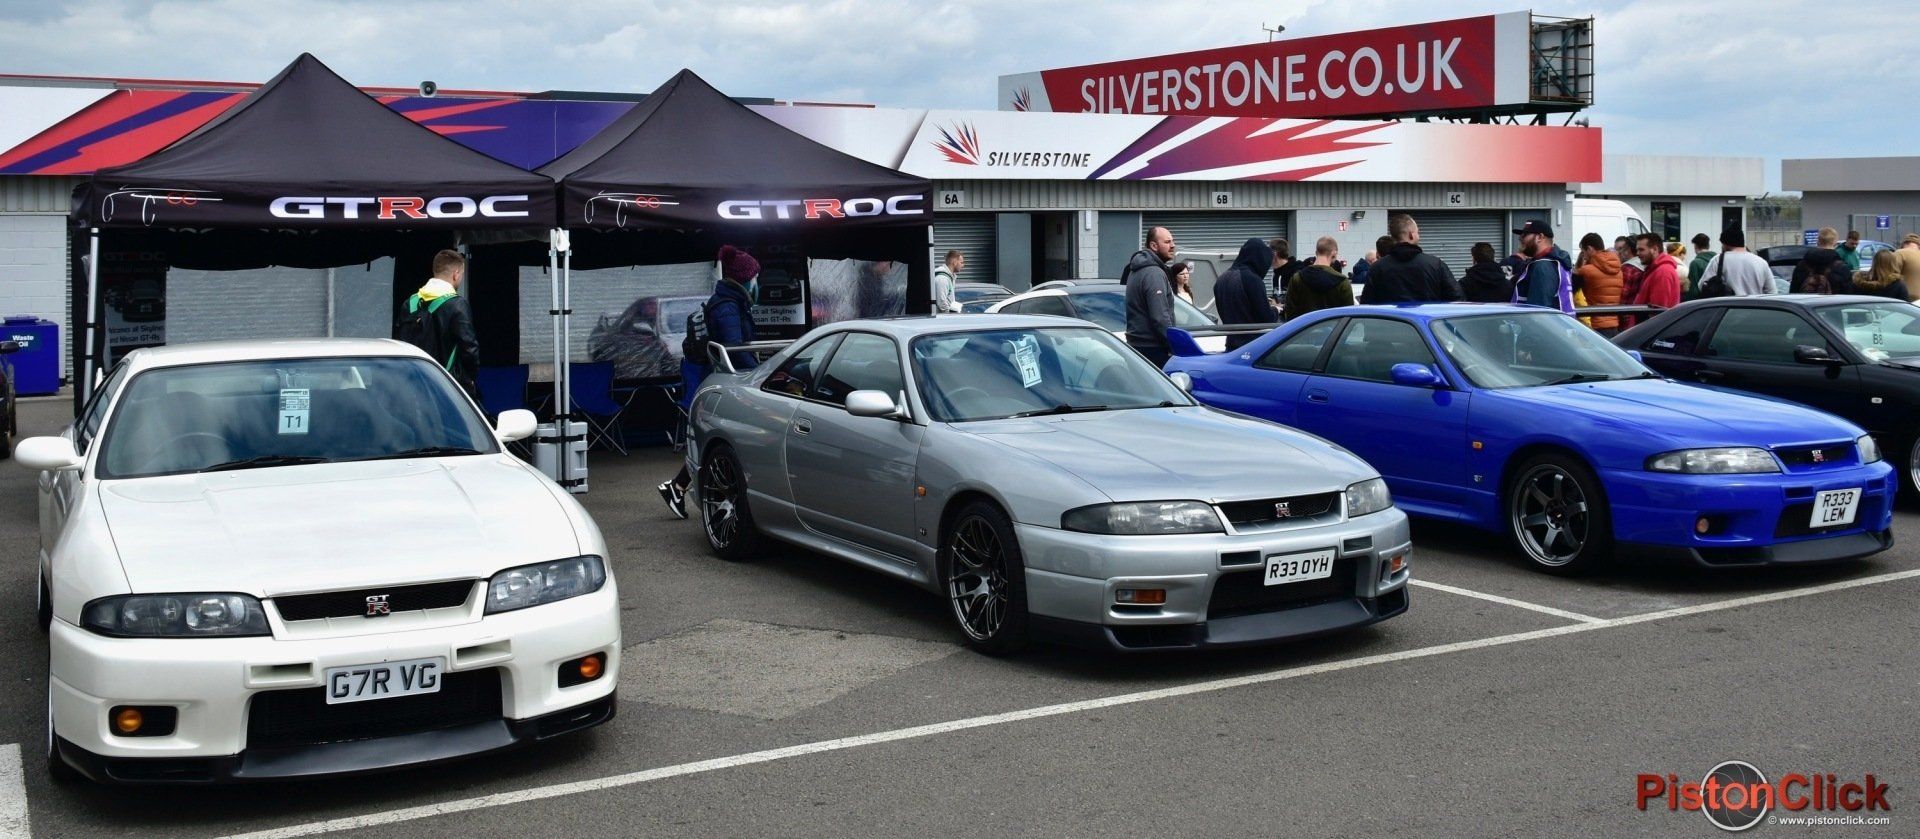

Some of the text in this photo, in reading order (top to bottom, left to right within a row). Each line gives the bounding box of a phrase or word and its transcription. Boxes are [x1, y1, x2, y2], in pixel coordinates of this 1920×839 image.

[1081, 37, 1463, 114] SILVERSTONE.CO.UK
[987, 151, 1091, 168] SILVERSTONE
[269, 194, 529, 219] GTROC
[717, 194, 924, 219] GTROC
[944, 193, 959, 205] 6A
[1216, 194, 1228, 205] 6B
[1450, 194, 1461, 204] 6C
[284, 415, 301, 428] T1
[1823, 491, 1854, 508] R333
[1823, 507, 1847, 523] LEM
[1269, 557, 1329, 579] R33 OYH
[365, 594, 390, 603] GT
[366, 602, 391, 616] R
[331, 662, 437, 699] G7R VG
